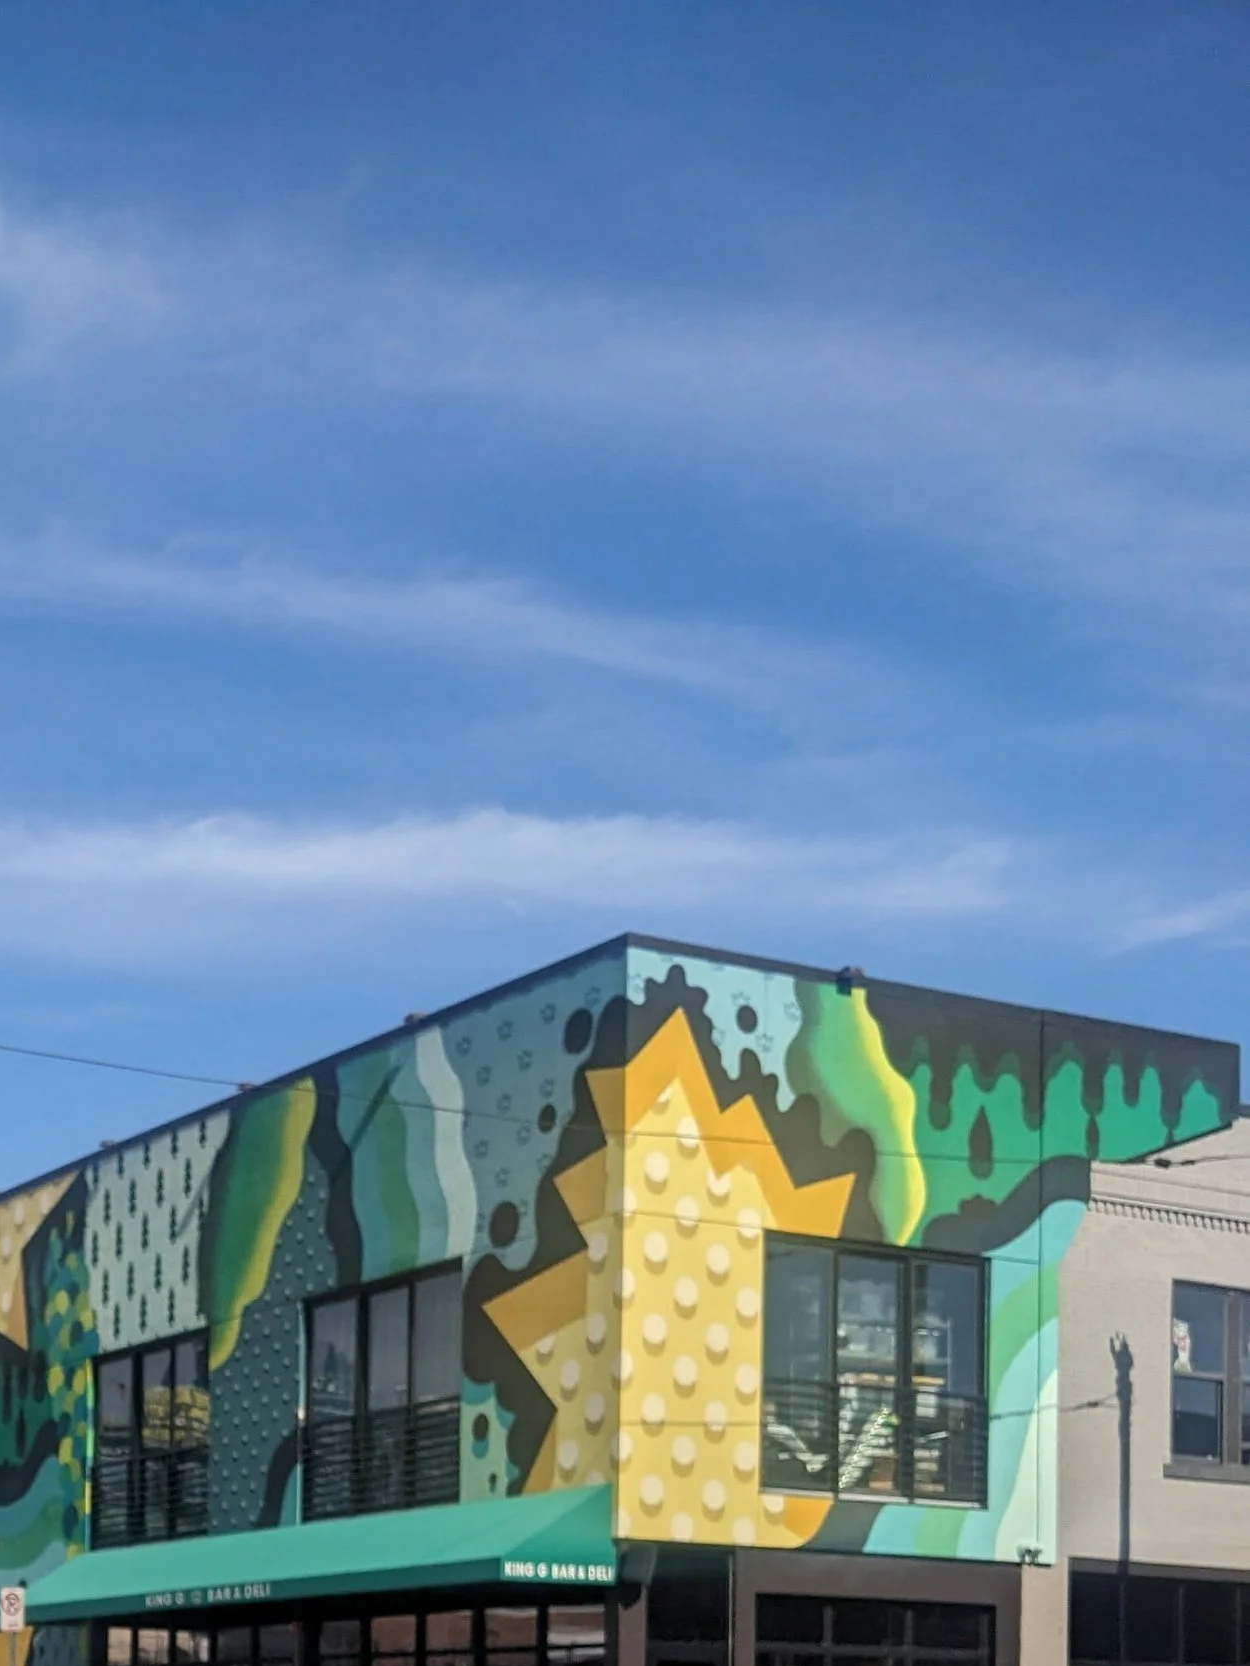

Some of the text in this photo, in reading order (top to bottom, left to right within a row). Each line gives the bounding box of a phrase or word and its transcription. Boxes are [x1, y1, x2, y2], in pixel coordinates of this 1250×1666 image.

[504, 1561, 535, 1577] KING
[537, 1562, 548, 1578] G
[551, 1563, 576, 1580] BAR
[588, 1565, 611, 1580] DELI
[207, 1588, 231, 1602] BAR
[244, 1583, 270, 1599] DELI
